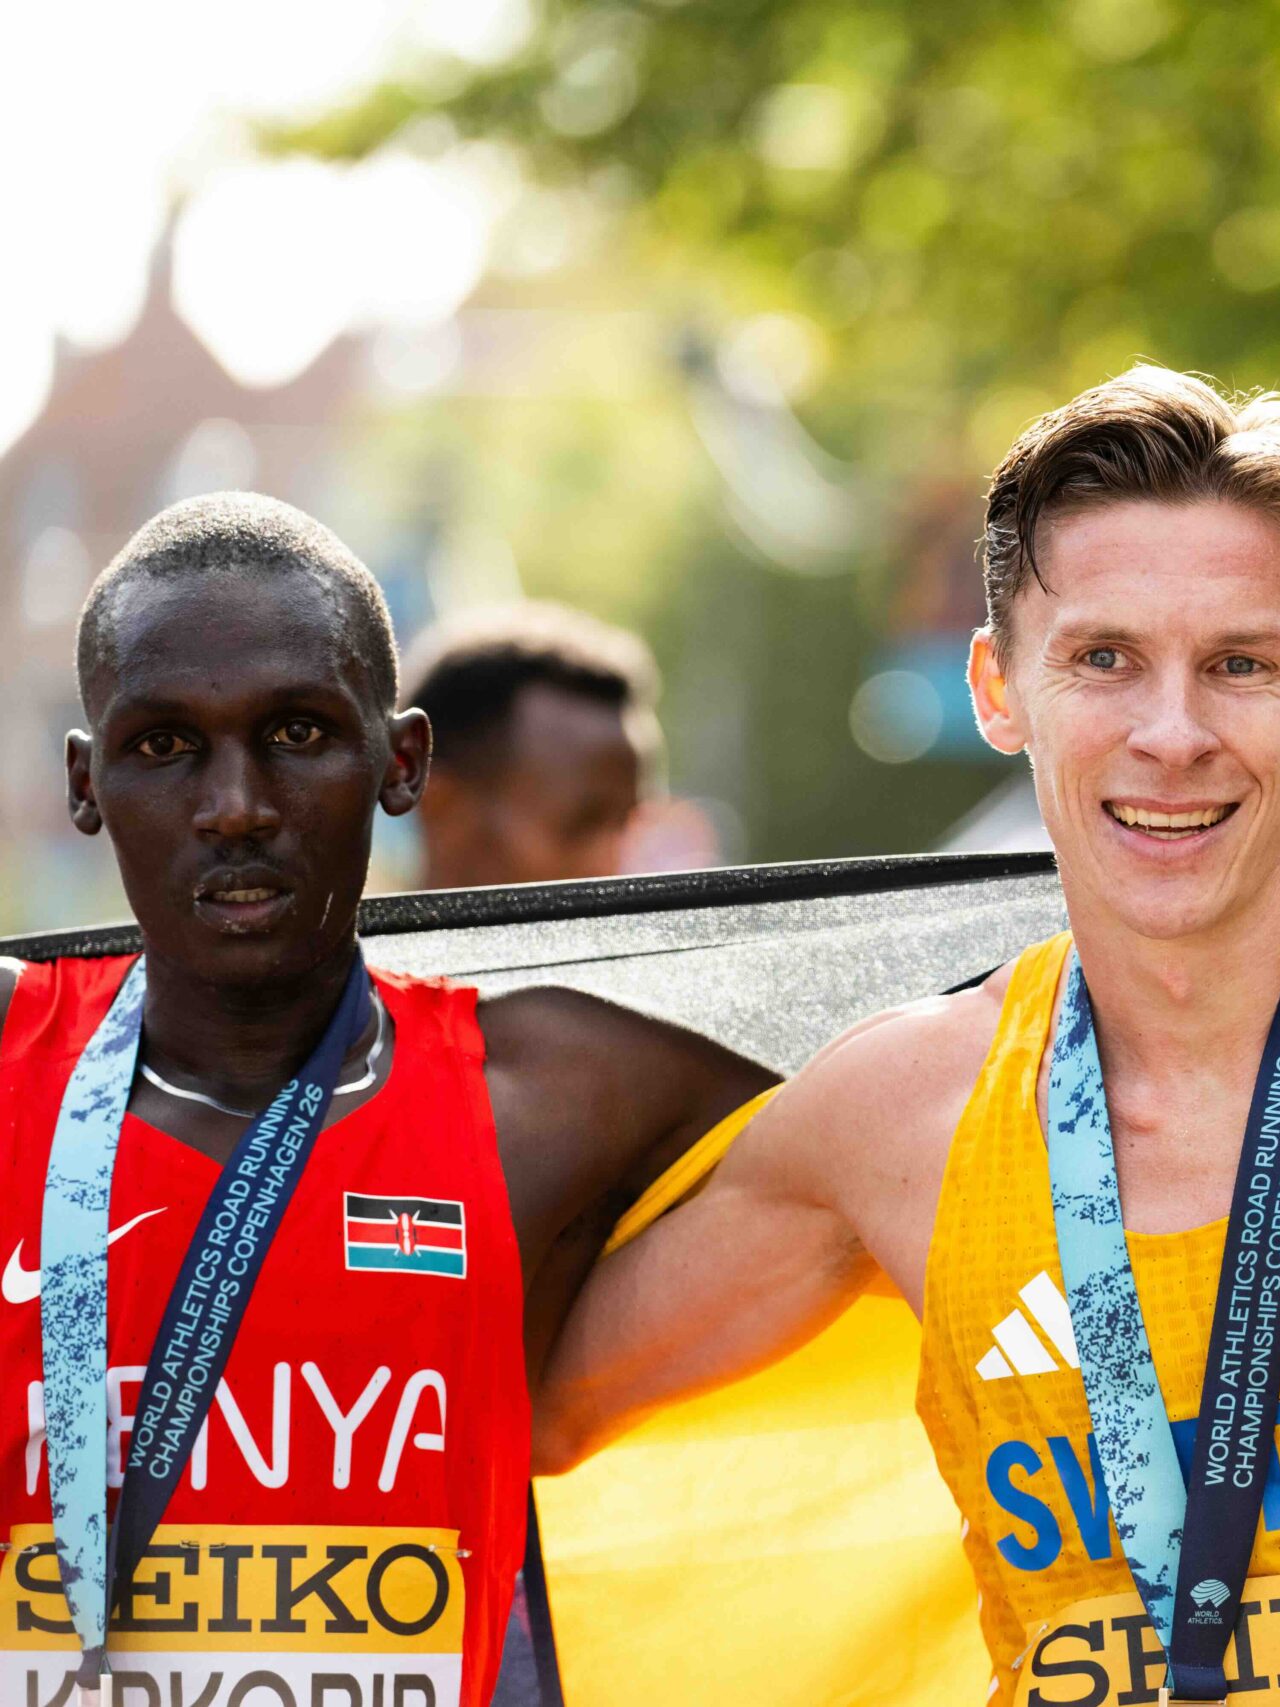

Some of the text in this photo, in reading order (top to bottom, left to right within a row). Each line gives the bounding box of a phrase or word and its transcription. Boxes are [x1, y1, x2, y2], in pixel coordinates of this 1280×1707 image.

[128, 1381, 172, 1467] WORLD
[161, 1249, 222, 1380] ATHLETICS
[208, 1180, 250, 1247] ROAD
[149, 1083, 323, 1479] CHAMPIONSHIPS COPENHAGEN 26
[1204, 1392, 1236, 1486] WORLD
[1220, 1250, 1259, 1388] ATHLETICS
[1241, 1173, 1272, 1245] ROAD
[15, 1542, 449, 1636] SEIKO
[1194, 1610, 1220, 1618] WORLD
